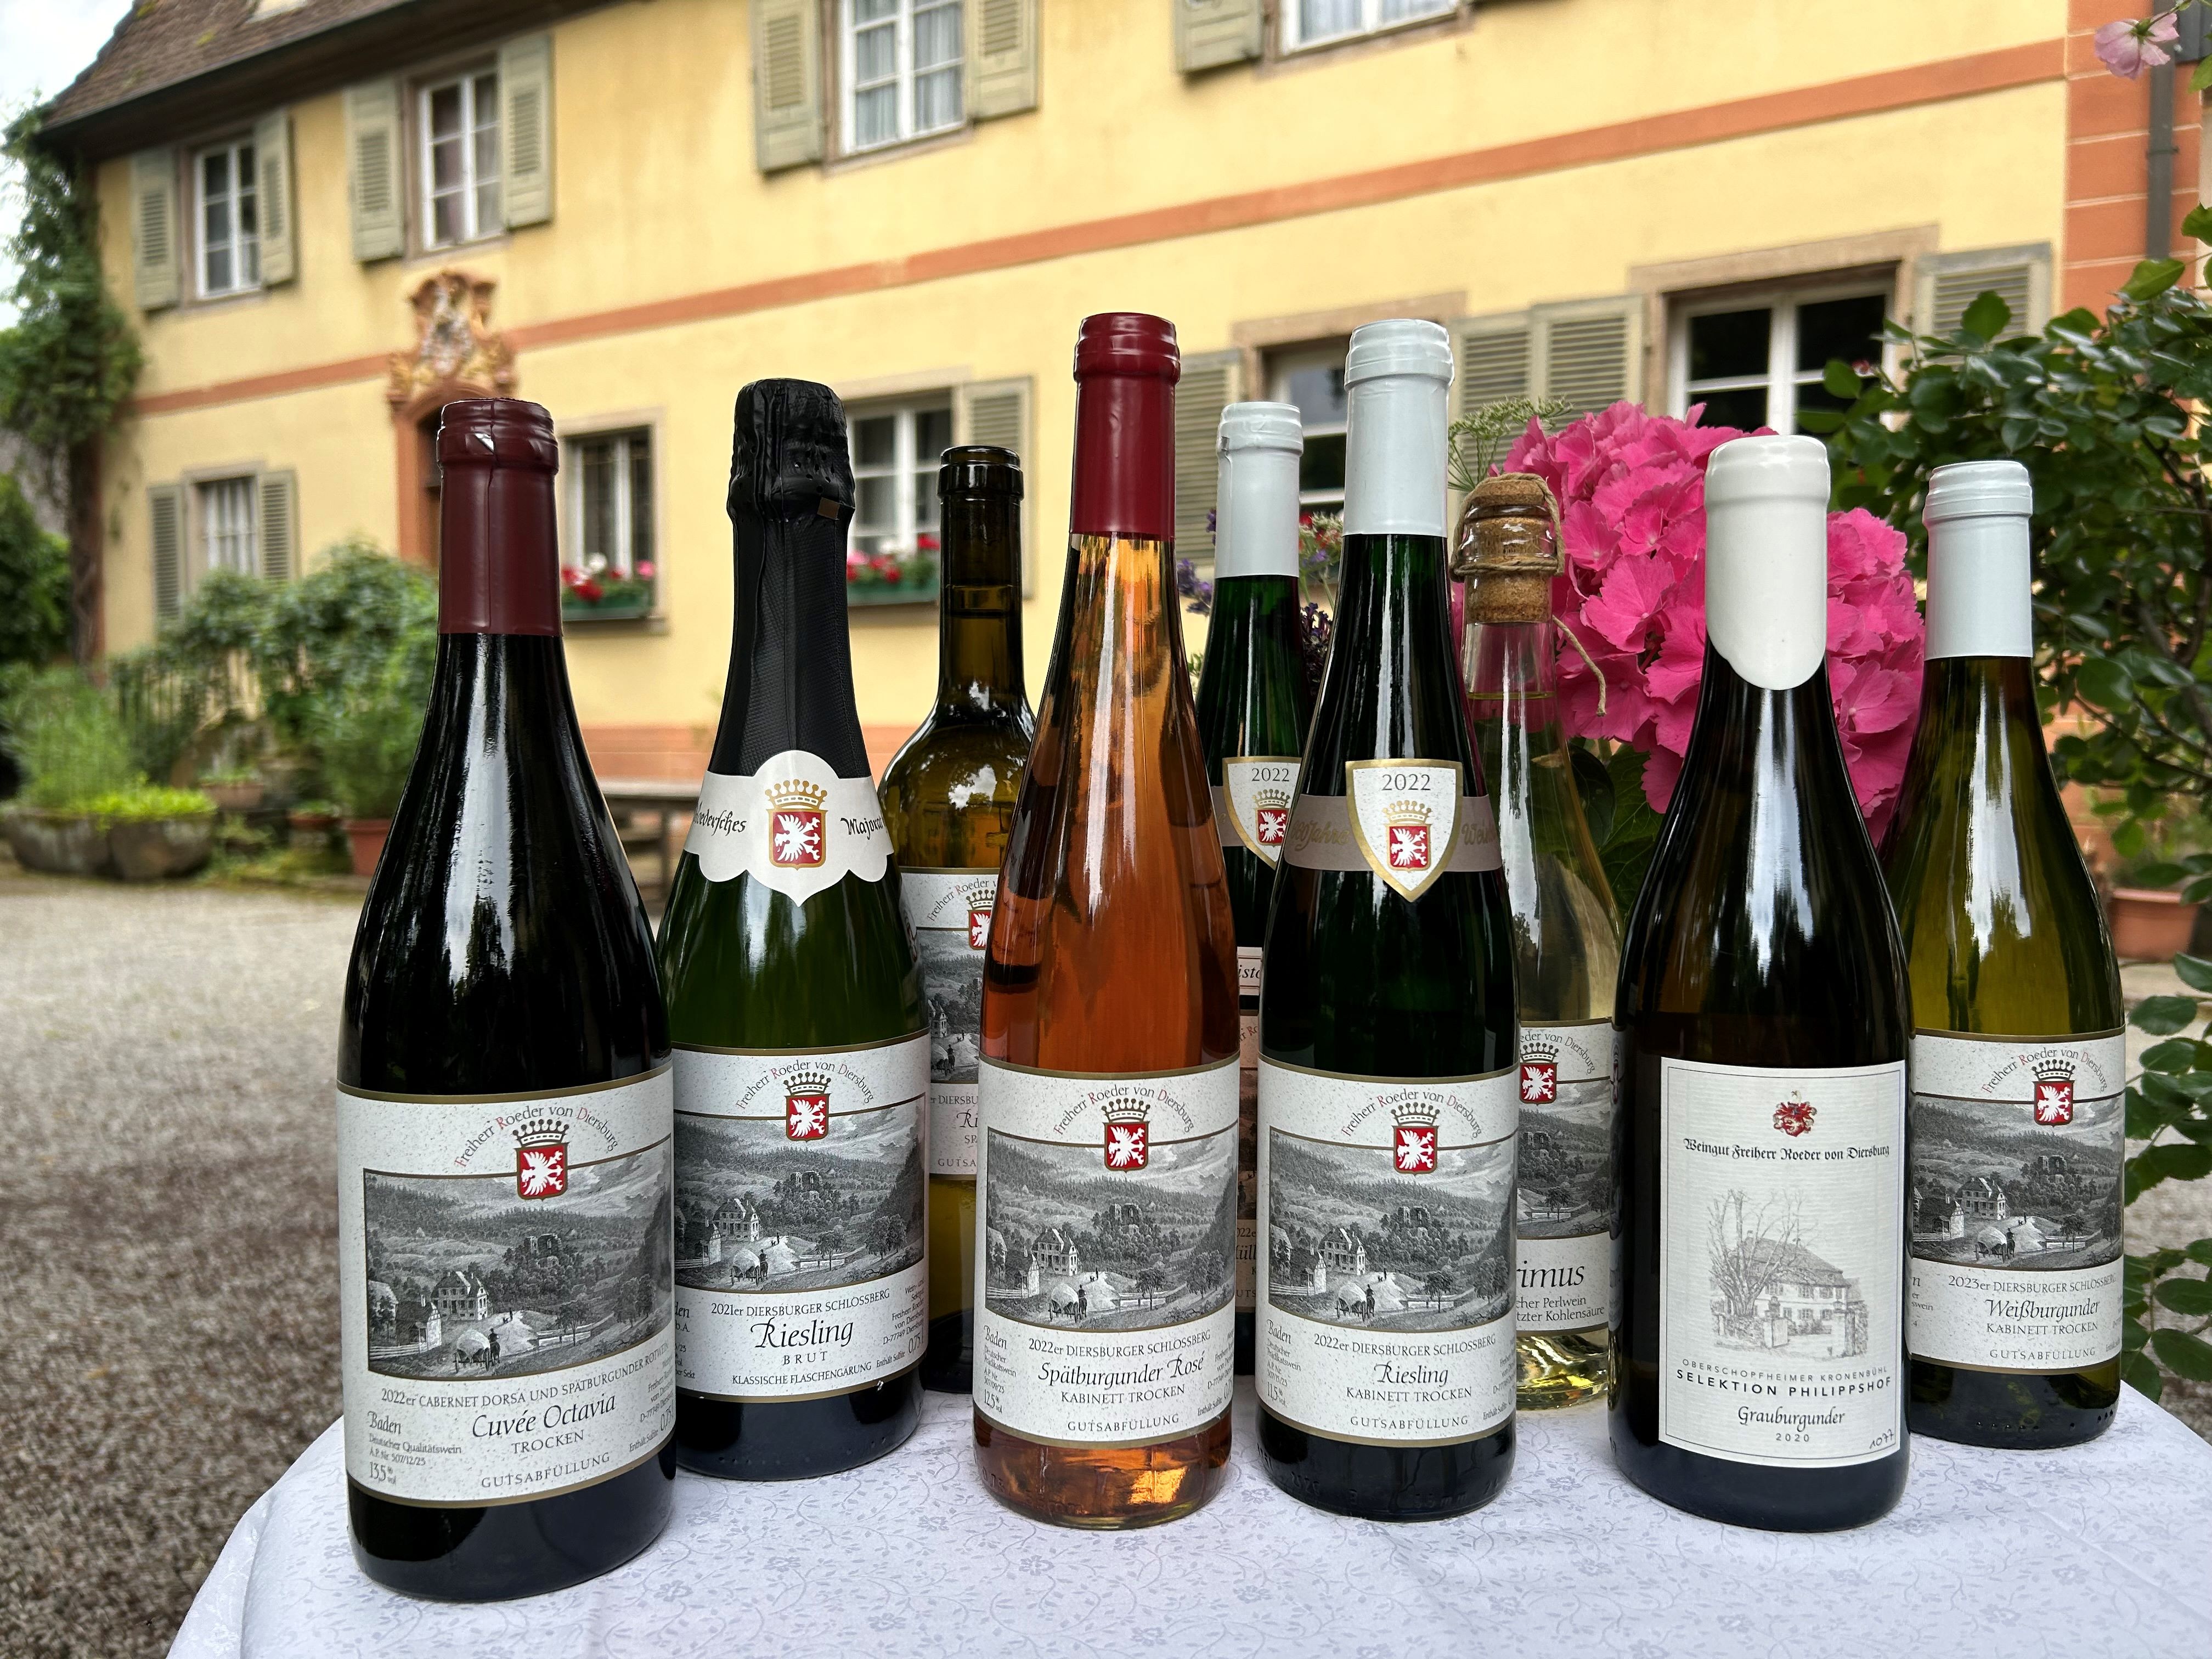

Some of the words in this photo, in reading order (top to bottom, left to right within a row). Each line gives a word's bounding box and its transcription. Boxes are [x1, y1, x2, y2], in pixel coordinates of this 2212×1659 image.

[1251, 768, 1290, 782] 2022
[1381, 774, 1431, 791] 2022
[927, 891, 955, 922] Freiherr
[955, 878, 990, 895] Roeder
[1545, 1034, 1563, 1043] von
[1565, 1036, 1595, 1074] Diersburg
[1982, 1062, 2017, 1093] Freiherr
[2018, 1047, 2057, 1066] Roeder
[2061, 1049, 2079, 1059] von
[2081, 1051, 2108, 1093] Diersburg
[736, 1076, 769, 1110] Freiherr
[770, 1060, 811, 1080] Roeder
[815, 1062, 836, 1073] von
[838, 1063, 874, 1104] Diersburg
[1053, 1098, 1087, 1136] Freiherr
[1087, 1085, 1128, 1105] Roeder
[1133, 1086, 1155, 1097] von
[1158, 1088, 1194, 1133] Diersburg
[1341, 1102, 1376, 1137] Freiherr
[1377, 1089, 1419, 1107] Roeder
[1423, 1091, 1444, 1104] von
[1447, 1095, 1482, 1139] Diersburg
[454, 1125, 495, 1168] Freiherr
[496, 1105, 545, 1130] Roeder
[549, 1106, 574, 1118] von
[576, 1107, 618, 1152] Diersburg
[964, 1135, 978, 1144] SP
[1684, 1138, 1730, 1156] Weingut
[1732, 1144, 1777, 1160] Freiherr
[1781, 1148, 1821, 1161] Roeder
[1825, 1150, 1844, 1160] von
[1847, 1145, 1890, 1160] Diersburg
[1949, 1276, 1990, 1290] 2023er
[1993, 1282, 2067, 1293] DIERSBURGER
[2069, 1273, 2117, 1291] SCHLOSSBERG
[711, 1302, 744, 1316] 2021er
[747, 1303, 822, 1317] DIERSBURGER
[826, 1288, 890, 1313] SCHLOSSBERG
[1543, 1296, 1587, 1308] Perlwein
[1546, 1307, 1605, 1321] Kohlensäure
[1985, 1298, 2101, 1322] Weißburgunder
[751, 1317, 854, 1348] Riesling
[984, 1325, 1007, 1350] Baden
[1267, 1319, 1291, 1344] Baden
[1987, 1323, 2049, 1334] KABINETT
[2053, 1322, 2098, 1334] TROCKEN
[1029, 1338, 1064, 1355] 2022er
[1066, 1344, 1144, 1357] DIERSBURGER
[1147, 1329, 1211, 1355] SCHLOSSBERG
[1314, 1334, 1350, 1351] 2022er
[1352, 1342, 1430, 1356] DIERSBURGER
[1433, 1334, 1496, 1356] SCHLOSSBERG
[1990, 1347, 2096, 1361] GUTSABFÜLLUNG
[783, 1351, 829, 1365] BRUT
[1038, 1362, 1163, 1390] Spätburgunder
[1167, 1350, 1206, 1379] Rosé
[1683, 1358, 1813, 1382] OBERSCHOPFHEIMER
[1821, 1365, 1887, 1382] KRONENBÜHL
[381, 1387, 416, 1406] 2022er
[419, 1395, 478, 1408] CABERNET
[482, 1390, 526, 1407] DORSA
[529, 1387, 558, 1402] UND
[562, 1358, 644, 1395] SPÄTBURGUNDER
[732, 1375, 788, 1385] KLASSISCHE
[1374, 1361, 1448, 1387] Riesling
[1677, 1369, 1777, 1396] SELEKTION
[1789, 1376, 1892, 1397] PHILIPPSHOF
[1061, 1391, 1124, 1405] KABINETT
[1128, 1384, 1185, 1403] TROCKEN
[1346, 1387, 1409, 1402] KABINETT
[1414, 1386, 1472, 1402] TROCKEN
[368, 1410, 402, 1435] Baden
[473, 1406, 537, 1437] Cuvée
[544, 1392, 617, 1429] Octavia
[1068, 1413, 1180, 1432] GUTSABFÜLLUNG
[1351, 1415, 1469, 1429] GUTSABFÜLLUNG
[1738, 1406, 1846, 1432] Grauburgunder
[403, 1441, 462, 1454] Qualitätswein
[511, 1430, 585, 1455] TROCKEN
[1776, 1433, 1810, 1442] 2020
[1869, 1429, 1894, 1449] 1077
[482, 1452, 611, 1488] GUTSABFÜLLUNG
